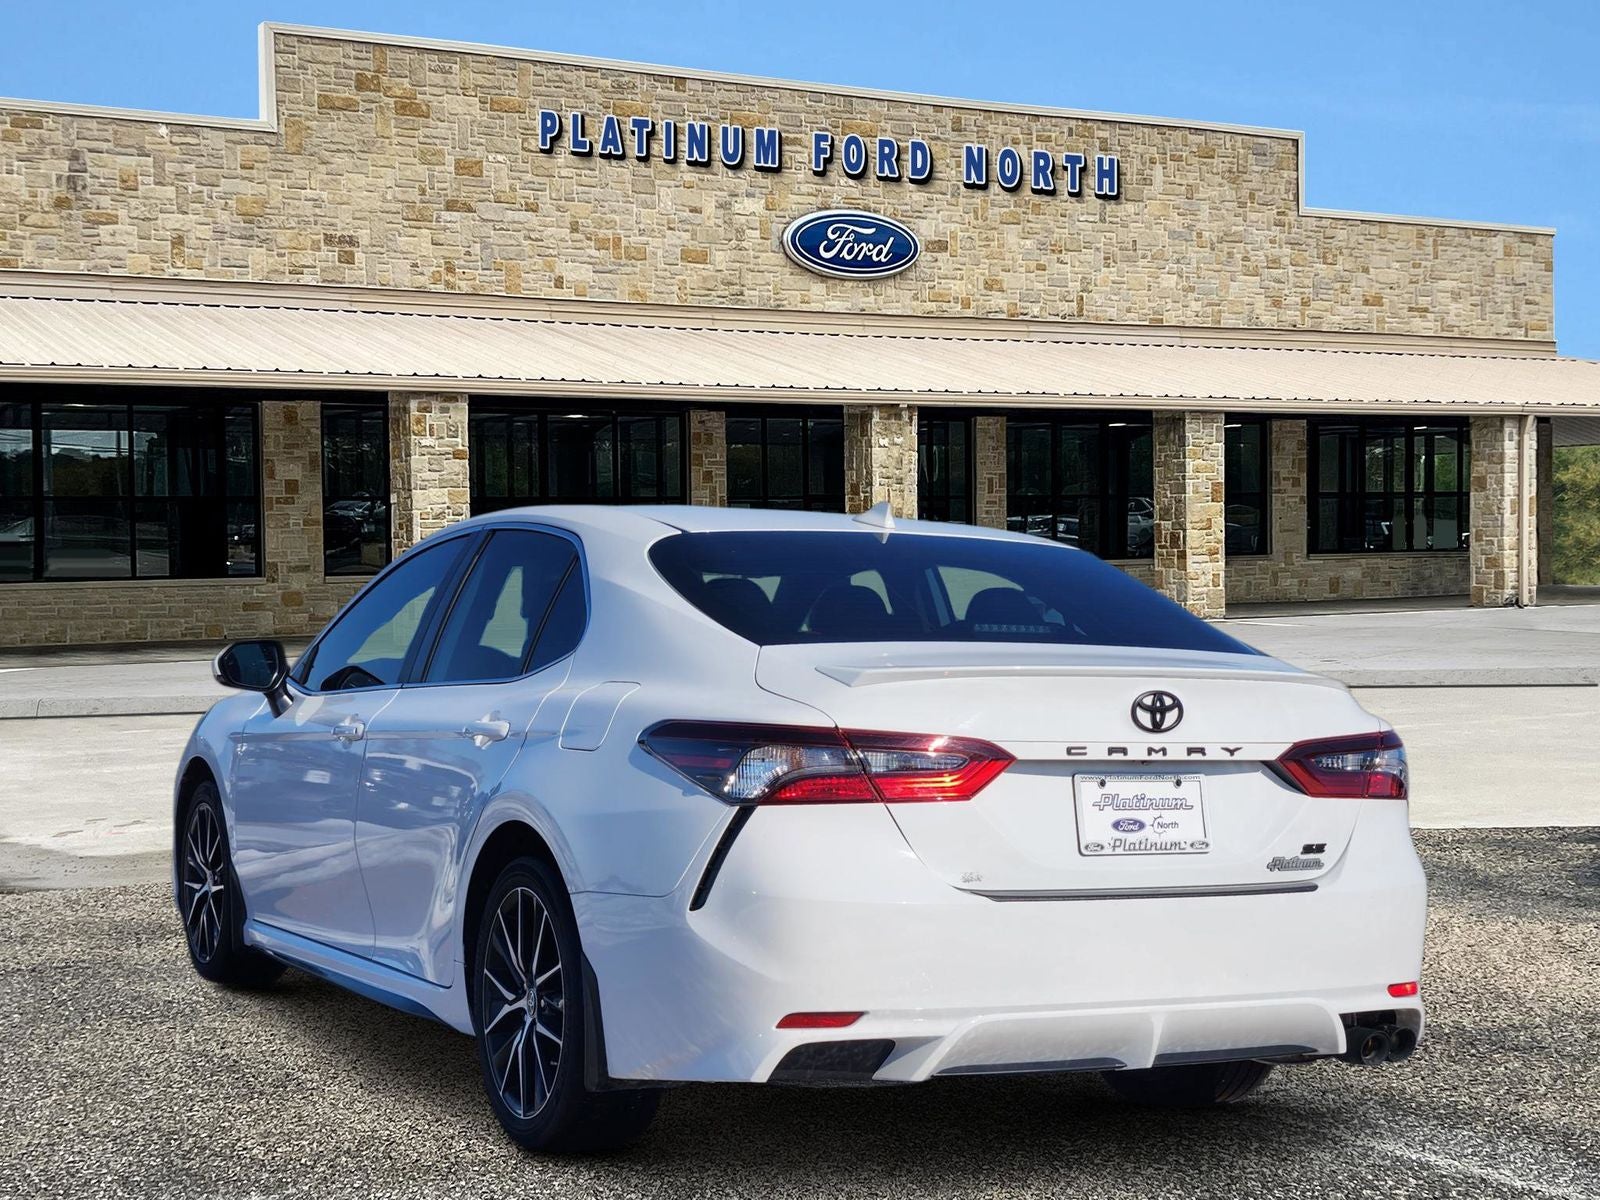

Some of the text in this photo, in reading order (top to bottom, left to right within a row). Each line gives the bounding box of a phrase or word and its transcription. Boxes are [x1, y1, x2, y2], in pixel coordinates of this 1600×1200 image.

[539, 110, 1120, 200] PLATINUM FORD NORTH
[818, 223, 894, 263] Ford
[1066, 746, 1243, 757] CAMRY
[1092, 793, 1194, 811] Platinum
[1156, 820, 1179, 830] North
[1110, 838, 1187, 852] Platinum
[1266, 856, 1324, 872] Platinum
